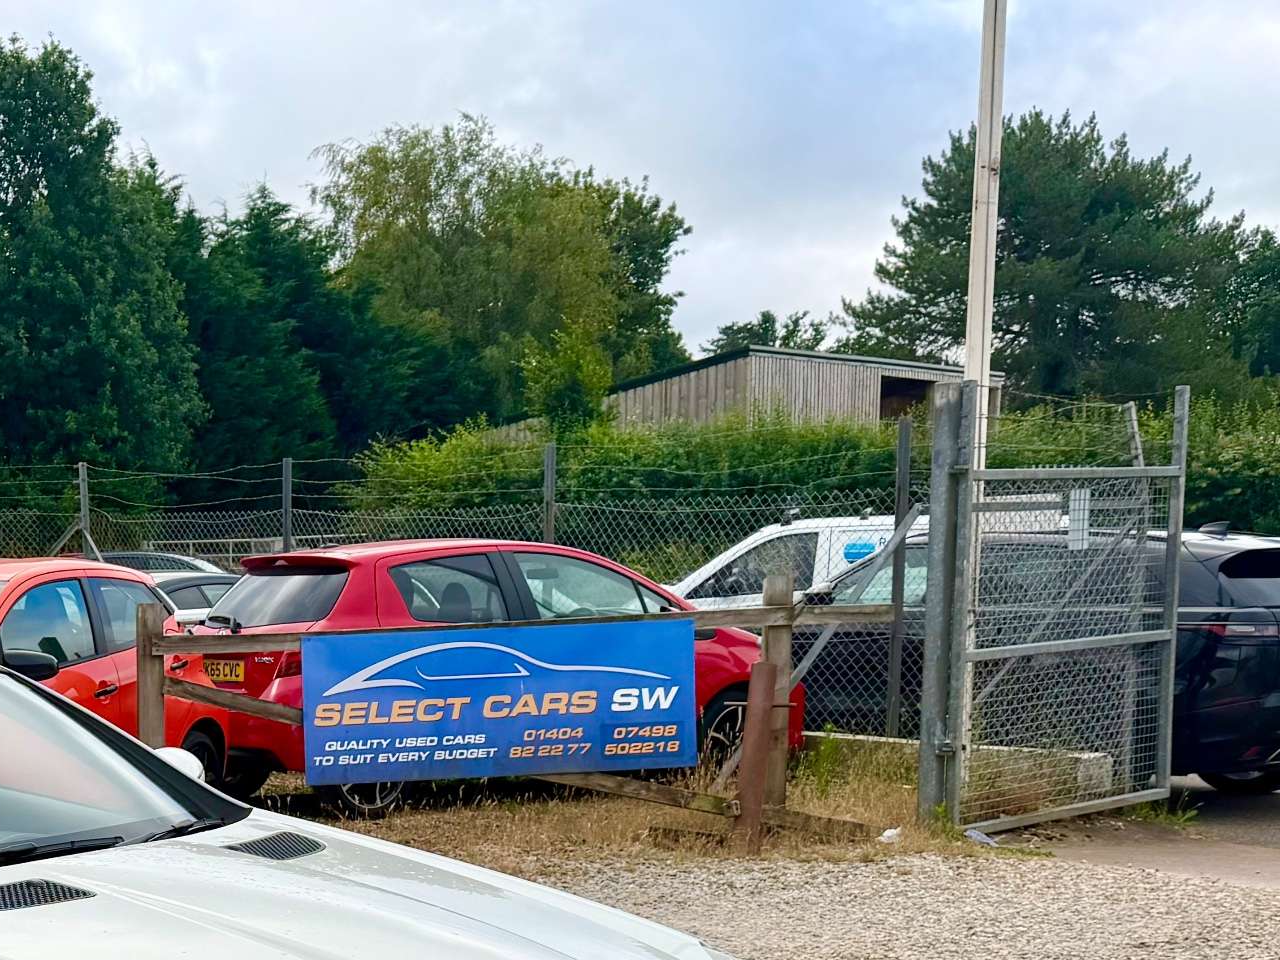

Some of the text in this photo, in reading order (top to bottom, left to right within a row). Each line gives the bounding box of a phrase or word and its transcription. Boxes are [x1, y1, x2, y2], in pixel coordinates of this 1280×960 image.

[223, 662, 240, 678] CVC
[314, 685, 679, 728] SELECT CARS SW
[523, 727, 584, 741] 01404
[613, 725, 678, 739] 07498
[325, 734, 486, 751] QUALITY USED CARS
[604, 740, 680, 755] 502218
[314, 748, 498, 766] TO SUIT EVERY BUDGET
